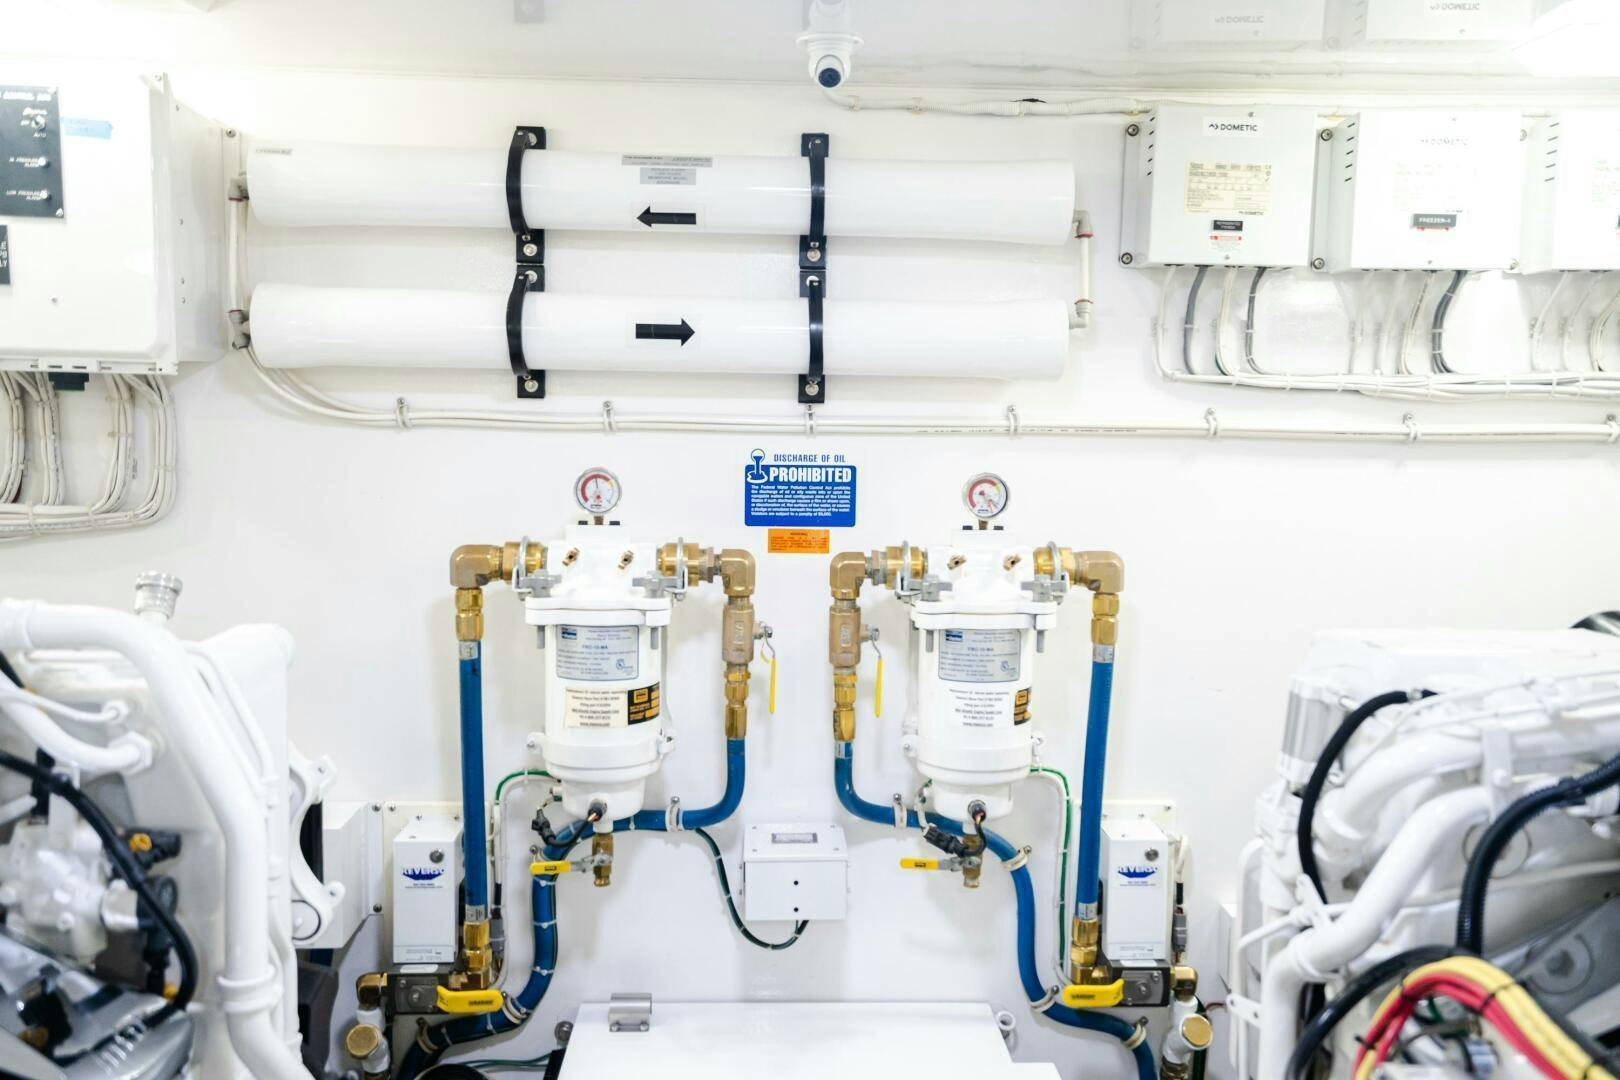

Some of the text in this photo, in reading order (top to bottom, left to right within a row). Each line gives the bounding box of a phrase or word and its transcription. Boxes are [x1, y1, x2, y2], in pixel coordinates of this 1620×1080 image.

[1220, 124, 1258, 132] DOMETIC
[774, 454, 818, 462] DISCHARGE
[769, 467, 852, 483] PROHIBITED
